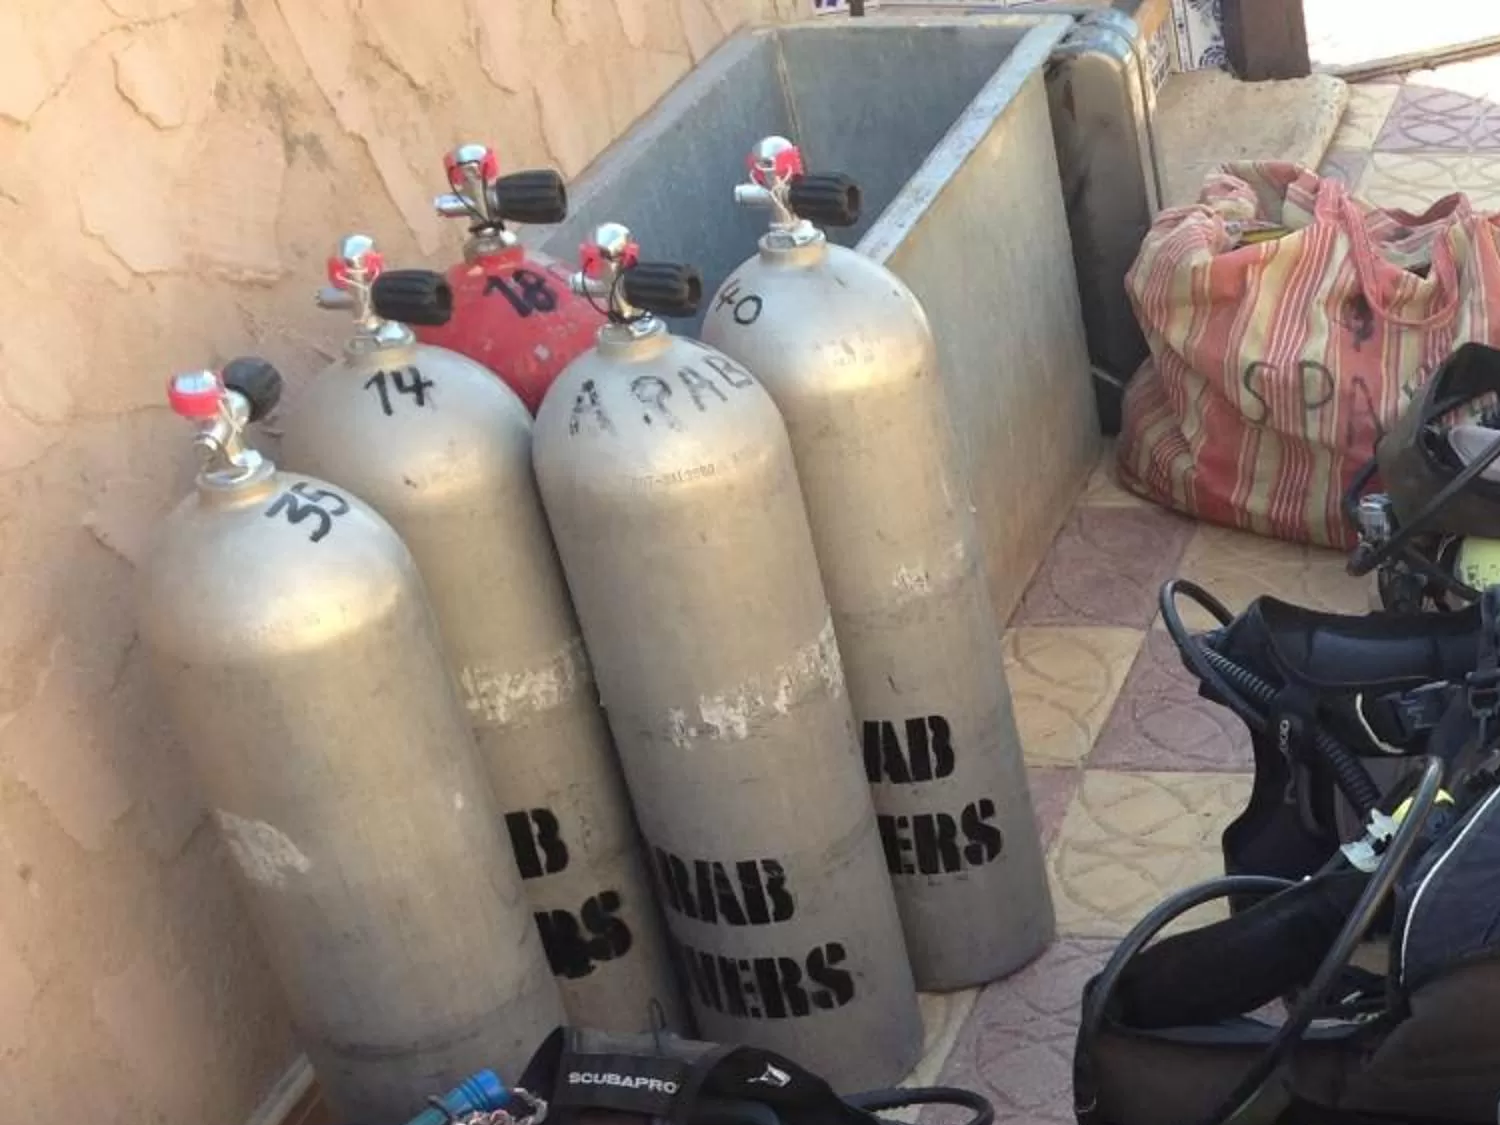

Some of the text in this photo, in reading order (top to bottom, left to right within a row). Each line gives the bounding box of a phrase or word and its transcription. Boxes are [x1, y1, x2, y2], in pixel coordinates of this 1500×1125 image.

[482, 269, 558, 319] 18
[363, 365, 434, 417] 14
[504, 807, 570, 881] B
[877, 798, 1003, 875] ERS
[568, 1070, 678, 1096] SCUBAPRO
